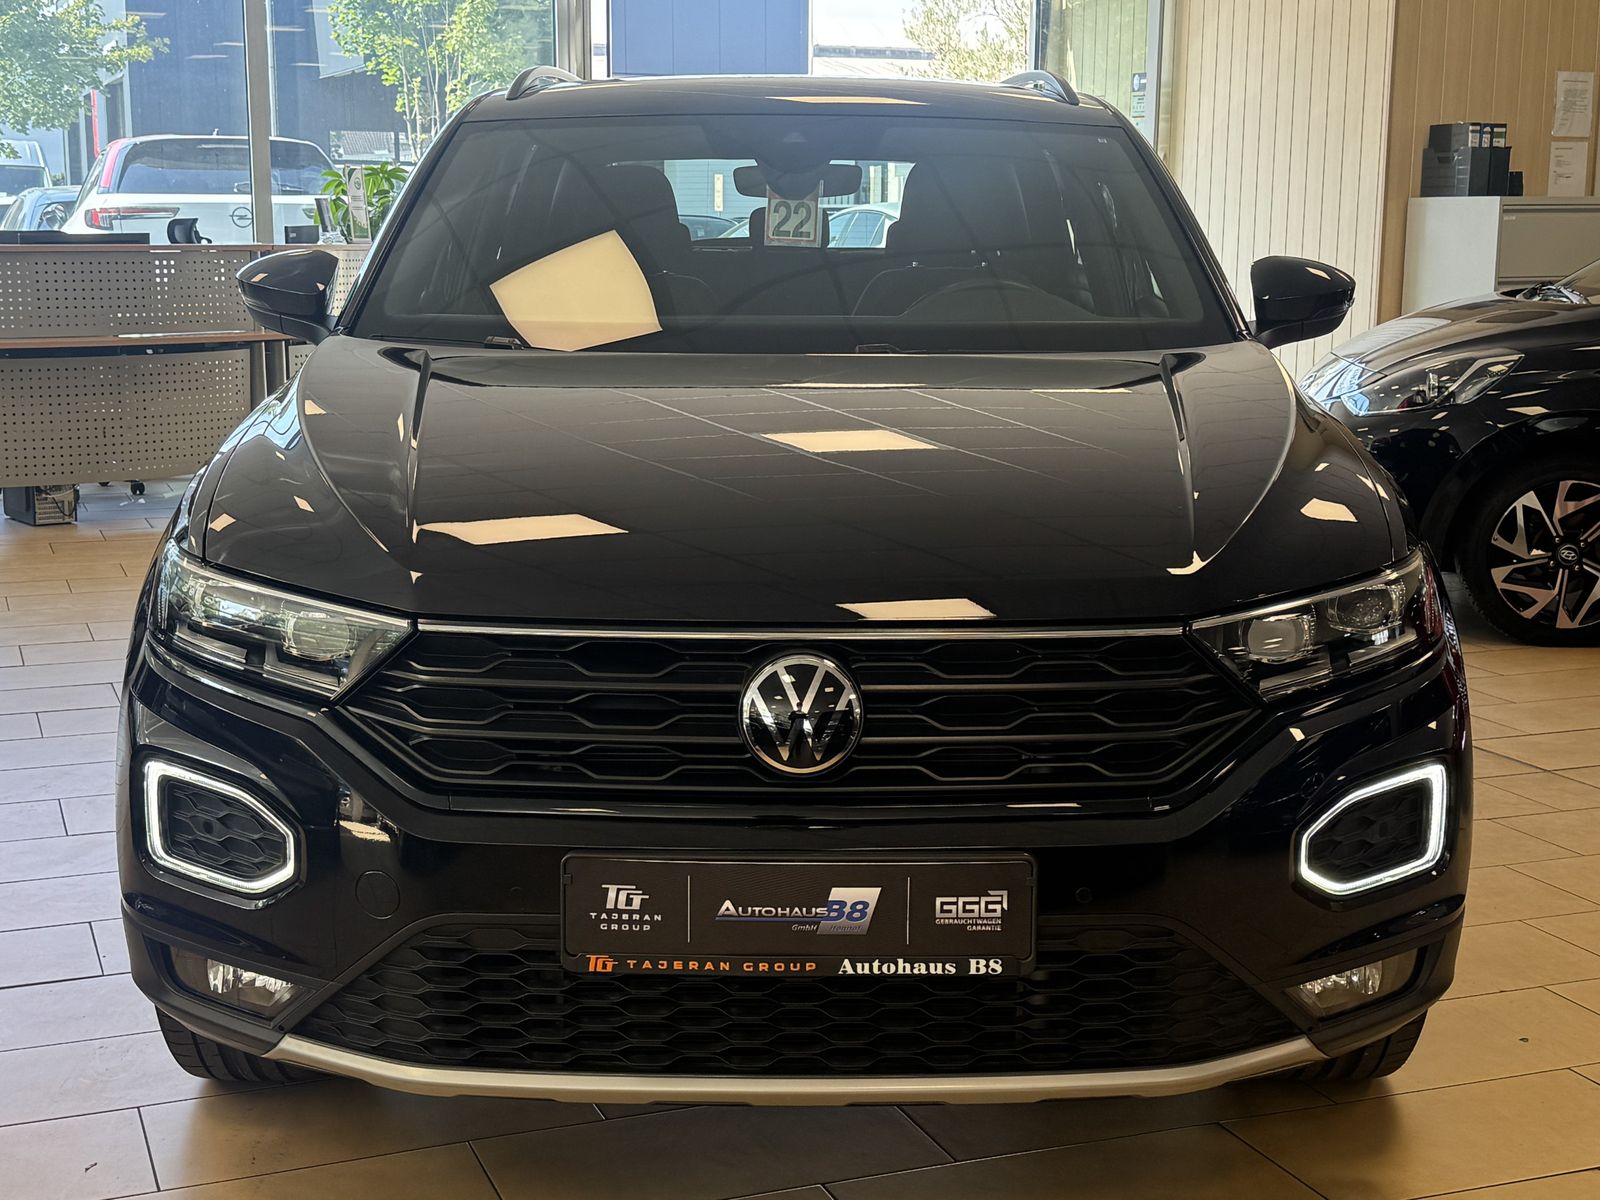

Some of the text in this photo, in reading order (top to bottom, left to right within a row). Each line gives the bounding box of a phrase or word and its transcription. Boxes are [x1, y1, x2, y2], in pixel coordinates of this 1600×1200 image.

[772, 201, 811, 238] 22
[826, 899, 870, 922] B8
[935, 896, 1002, 918] GGG
[600, 923, 651, 931] GROUP
[791, 924, 818, 932] GmbH
[627, 959, 733, 972] TAJERAN
[743, 961, 817, 972] GROUP
[838, 958, 1003, 975] Autohaus B8
